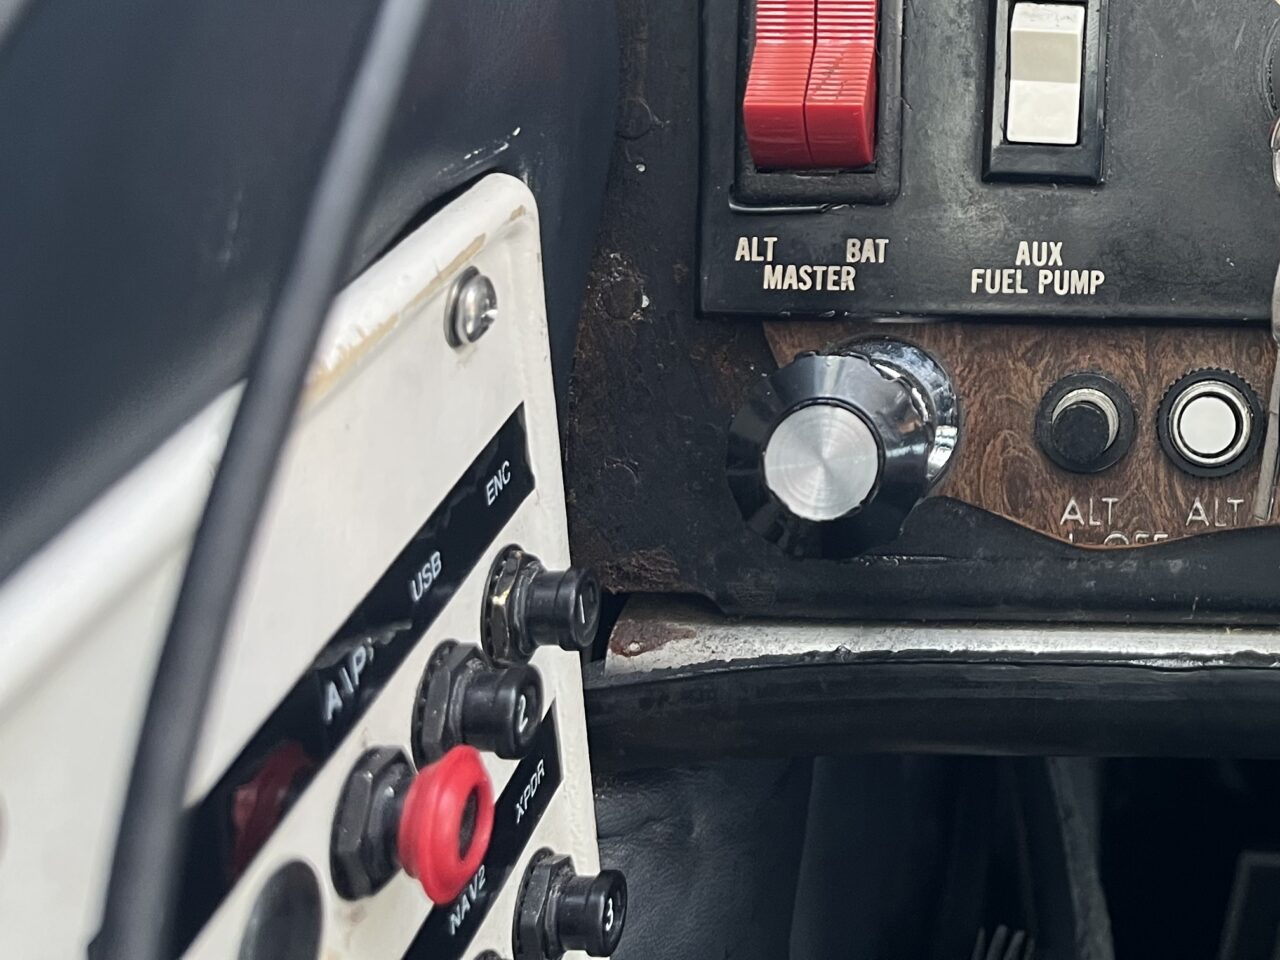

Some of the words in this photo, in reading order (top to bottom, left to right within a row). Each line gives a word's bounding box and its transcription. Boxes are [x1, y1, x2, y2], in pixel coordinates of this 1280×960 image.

[735, 237, 778, 262] ALT
[846, 238, 889, 263] BAT
[1015, 241, 1063, 266] AUX
[763, 265, 856, 291] MASTER
[971, 268, 1029, 294] FUEL
[1038, 269, 1105, 295] PUMP
[1060, 496, 1119, 527] ALT
[1186, 496, 1244, 527] ALT
[409, 551, 443, 602] USB
[486, 460, 511, 506] ENC
[517, 694, 529, 734] 2
[450, 865, 487, 935] NAV2
[515, 758, 546, 824] XPDR
[604, 896, 614, 932] 3
